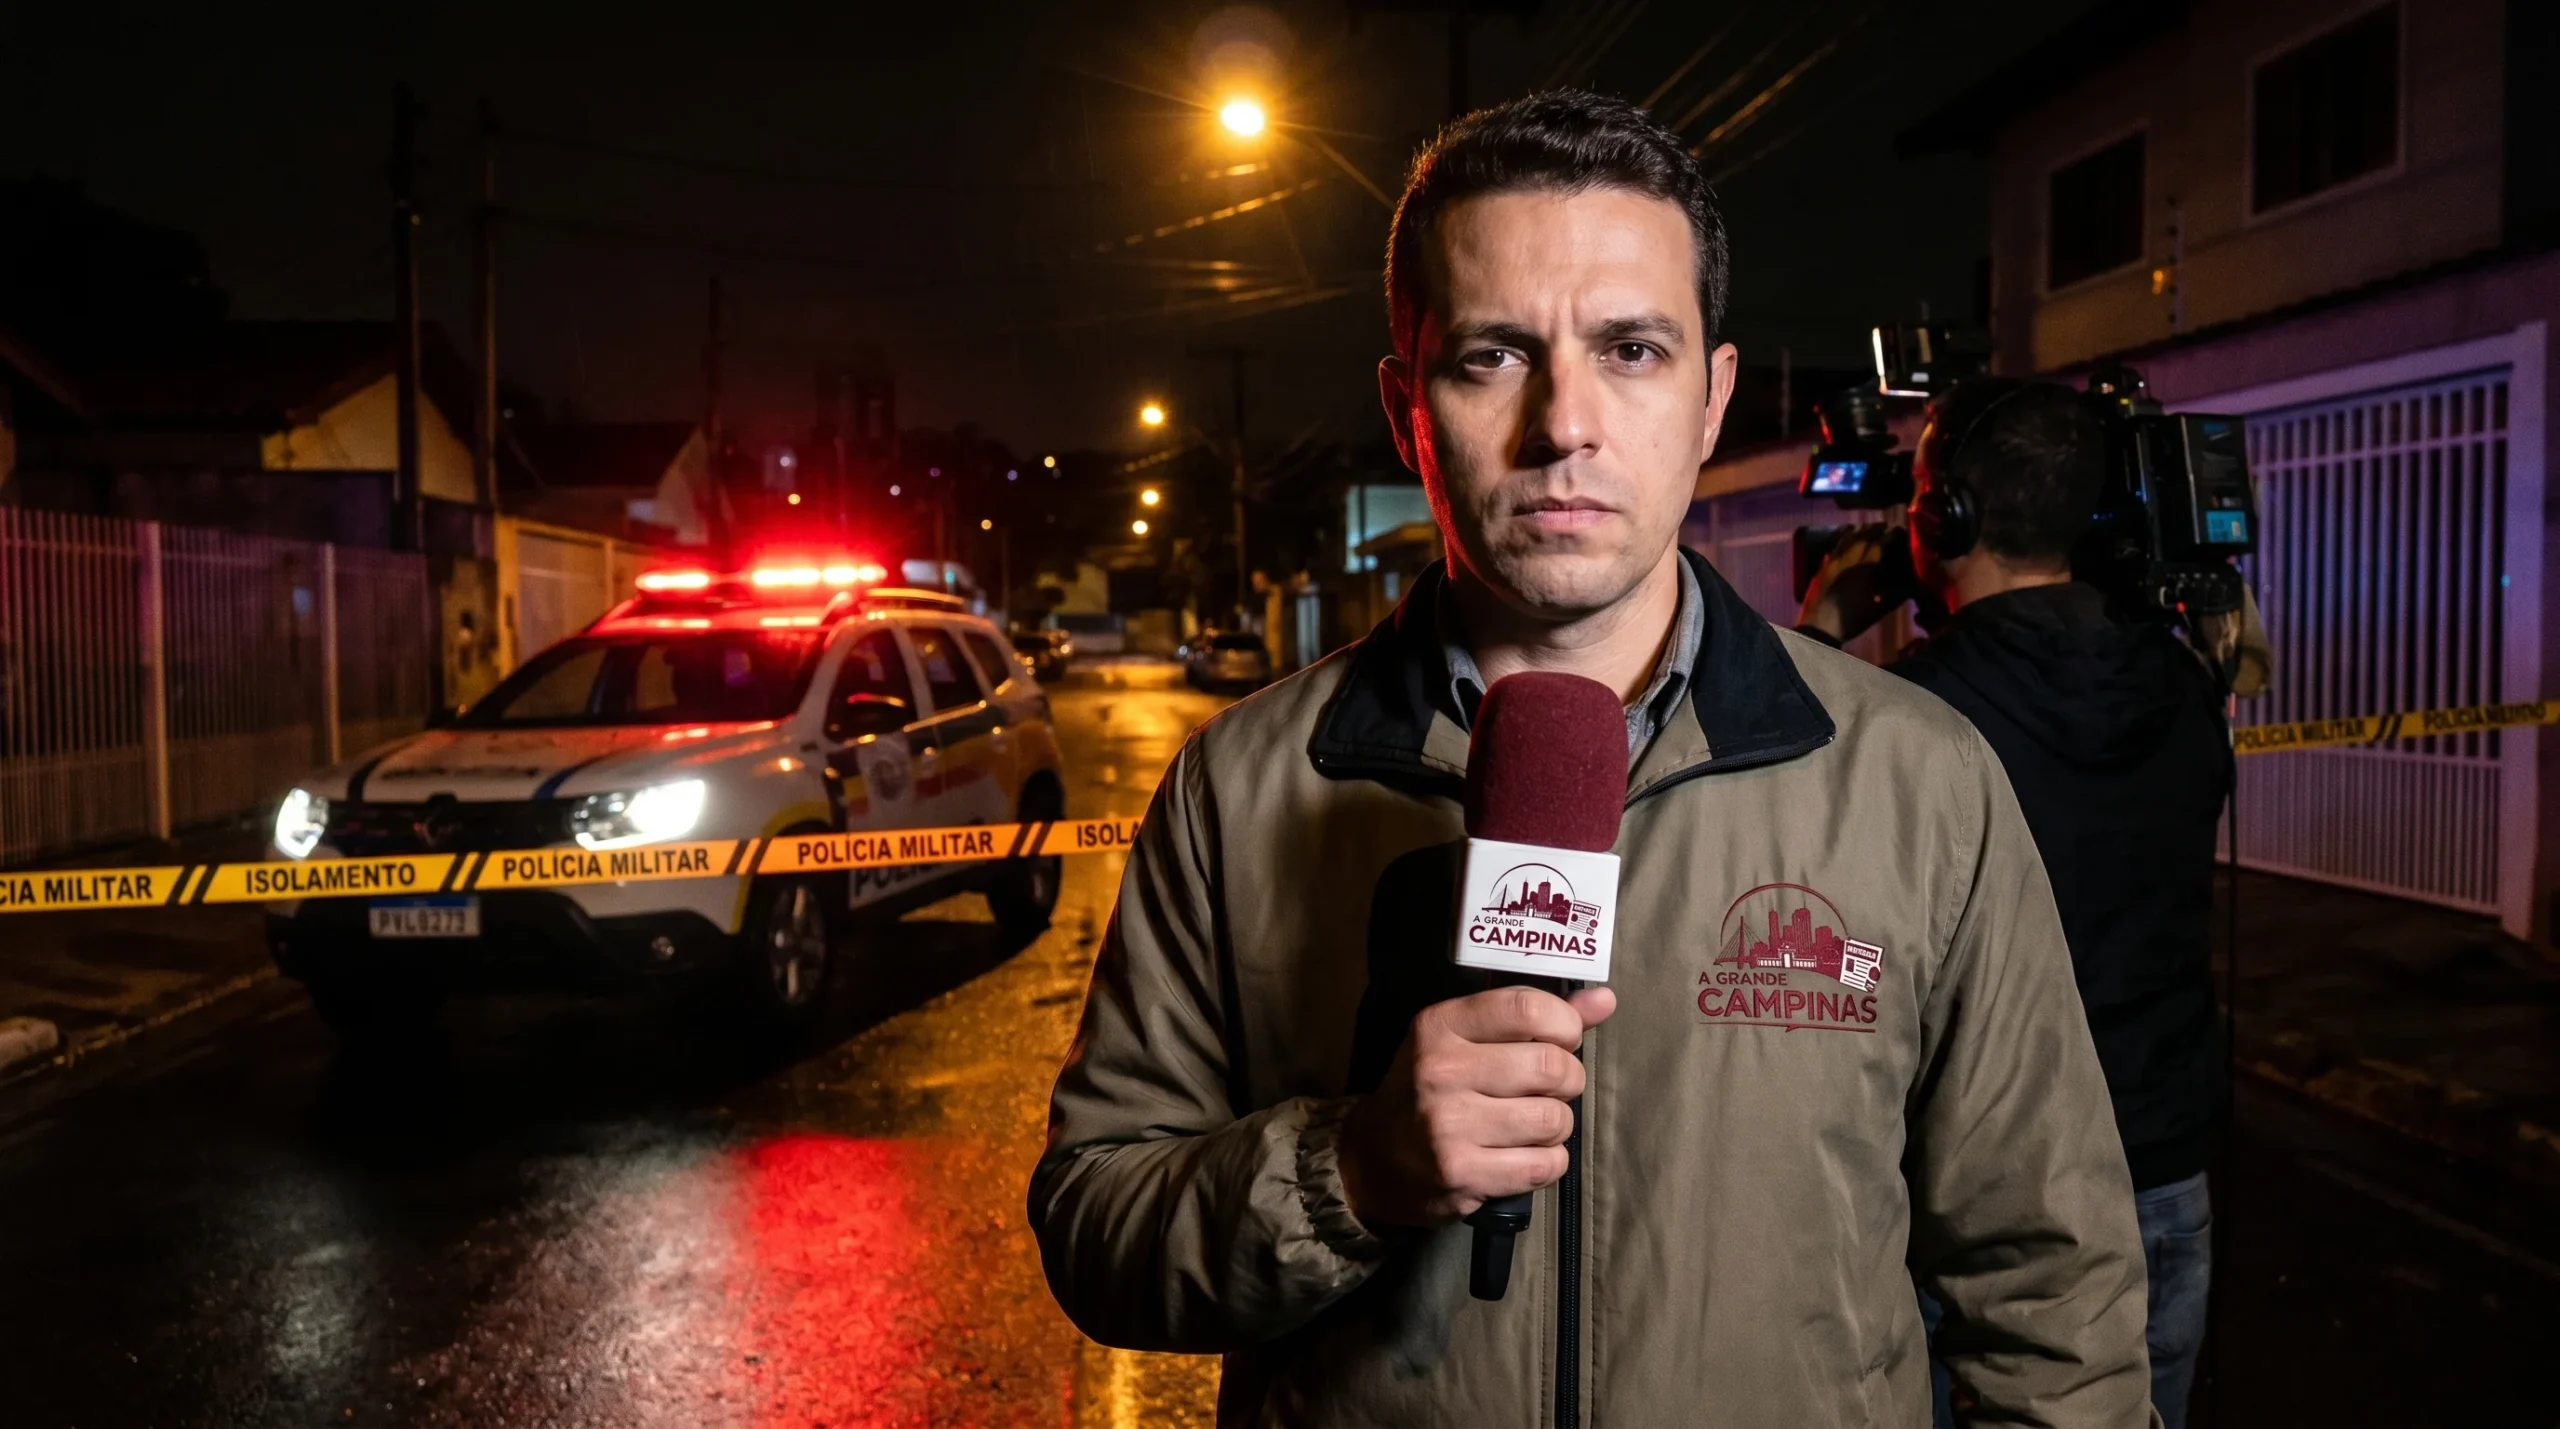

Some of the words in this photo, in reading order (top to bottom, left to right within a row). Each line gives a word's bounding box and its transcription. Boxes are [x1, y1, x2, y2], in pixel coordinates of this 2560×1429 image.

[899, 831, 994, 859] MILITAR
[246, 863, 416, 895] ISOLAMENTO
[503, 851, 602, 881] POLÍCIA
[610, 848, 710, 875] MILITAR
[44, 875, 152, 903] MILITAR
[1484, 916, 1525, 927] GRANDE
[1469, 925, 1597, 956] CAMPINAS
[1698, 971, 1710, 985] A
[1716, 972, 1788, 986] GRANDE
[1697, 988, 1878, 1023] CAMPINAS
